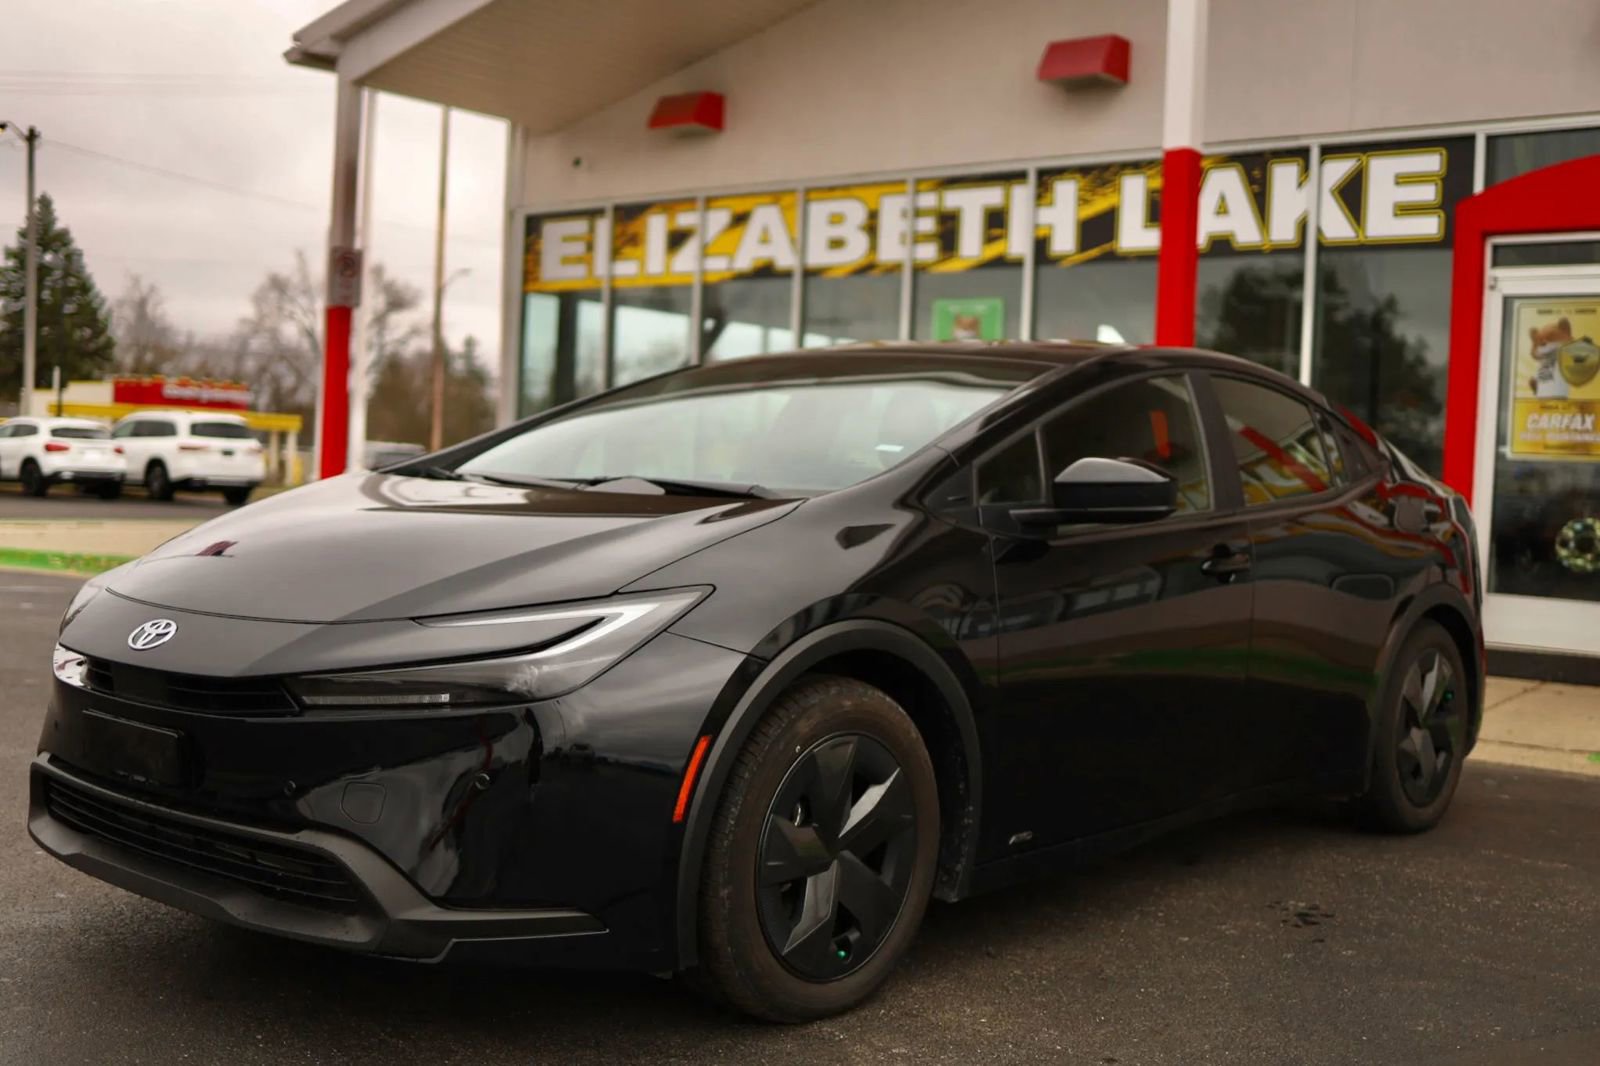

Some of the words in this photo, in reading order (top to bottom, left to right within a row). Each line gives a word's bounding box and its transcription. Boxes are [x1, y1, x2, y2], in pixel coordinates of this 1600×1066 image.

[539, 176, 1079, 282] ELIZABETH
[1117, 148, 1446, 254] LAKE
[1527, 412, 1597, 432] CARFAX
